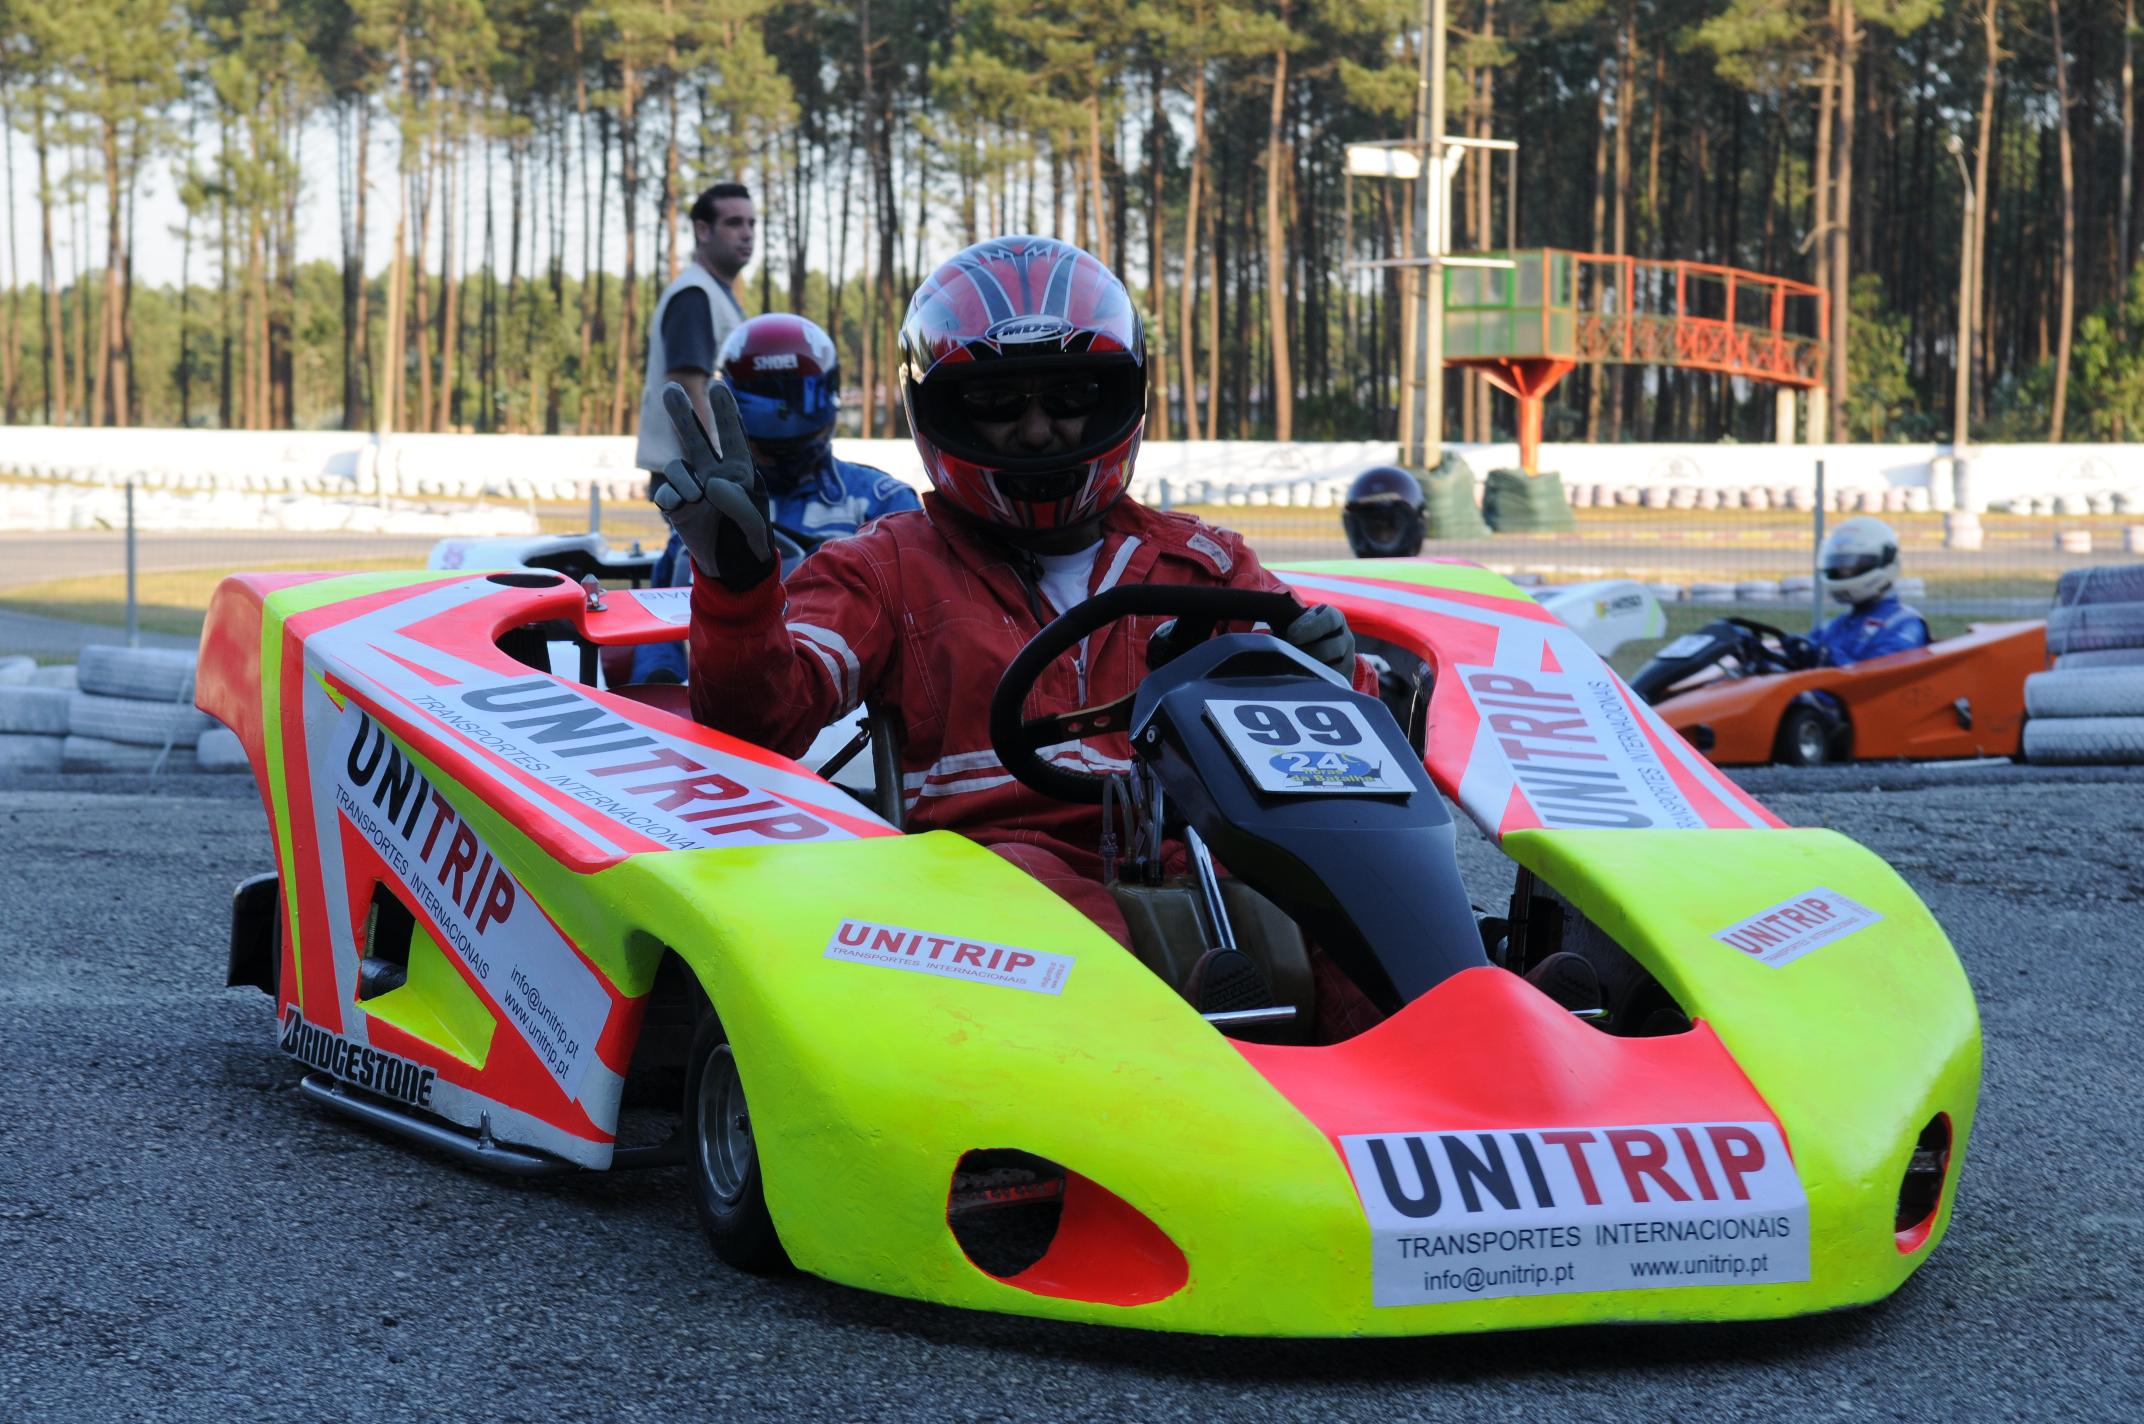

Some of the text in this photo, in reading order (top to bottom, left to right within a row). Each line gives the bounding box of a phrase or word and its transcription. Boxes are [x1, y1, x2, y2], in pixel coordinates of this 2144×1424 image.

[1001, 321, 1061, 337] MDS
[412, 694, 550, 773] TRANSPORTES
[461, 679, 830, 840] UNITRIP
[1233, 704, 1363, 746] 99
[1281, 752, 1349, 772] 24
[1468, 673, 1653, 829] UNITRIP
[1588, 680, 1654, 763] INTERNACIONAIS
[347, 710, 515, 936] UNITRIP
[336, 784, 490, 980] TRANSPORTES INTERNACIONAIS
[833, 947, 920, 966] TRANSPORTES
[926, 962, 1027, 985] INTERNACIONAIS
[838, 923, 1036, 972] UNITRIP
[1721, 897, 1837, 954] UNITRIP
[504, 990, 569, 1079] www.unitrip.pt
[511, 964, 579, 1059] info@unitrip.pt
[280, 1007, 435, 1107] BRIDGESTONE
[1366, 1125, 1766, 1218] UNITRIP
[1397, 1217, 1791, 1259] TRANSPORTES INTERNACIONAIS
[1424, 1254, 1768, 1292] info@unitrip.pt www.unitrip.pt
